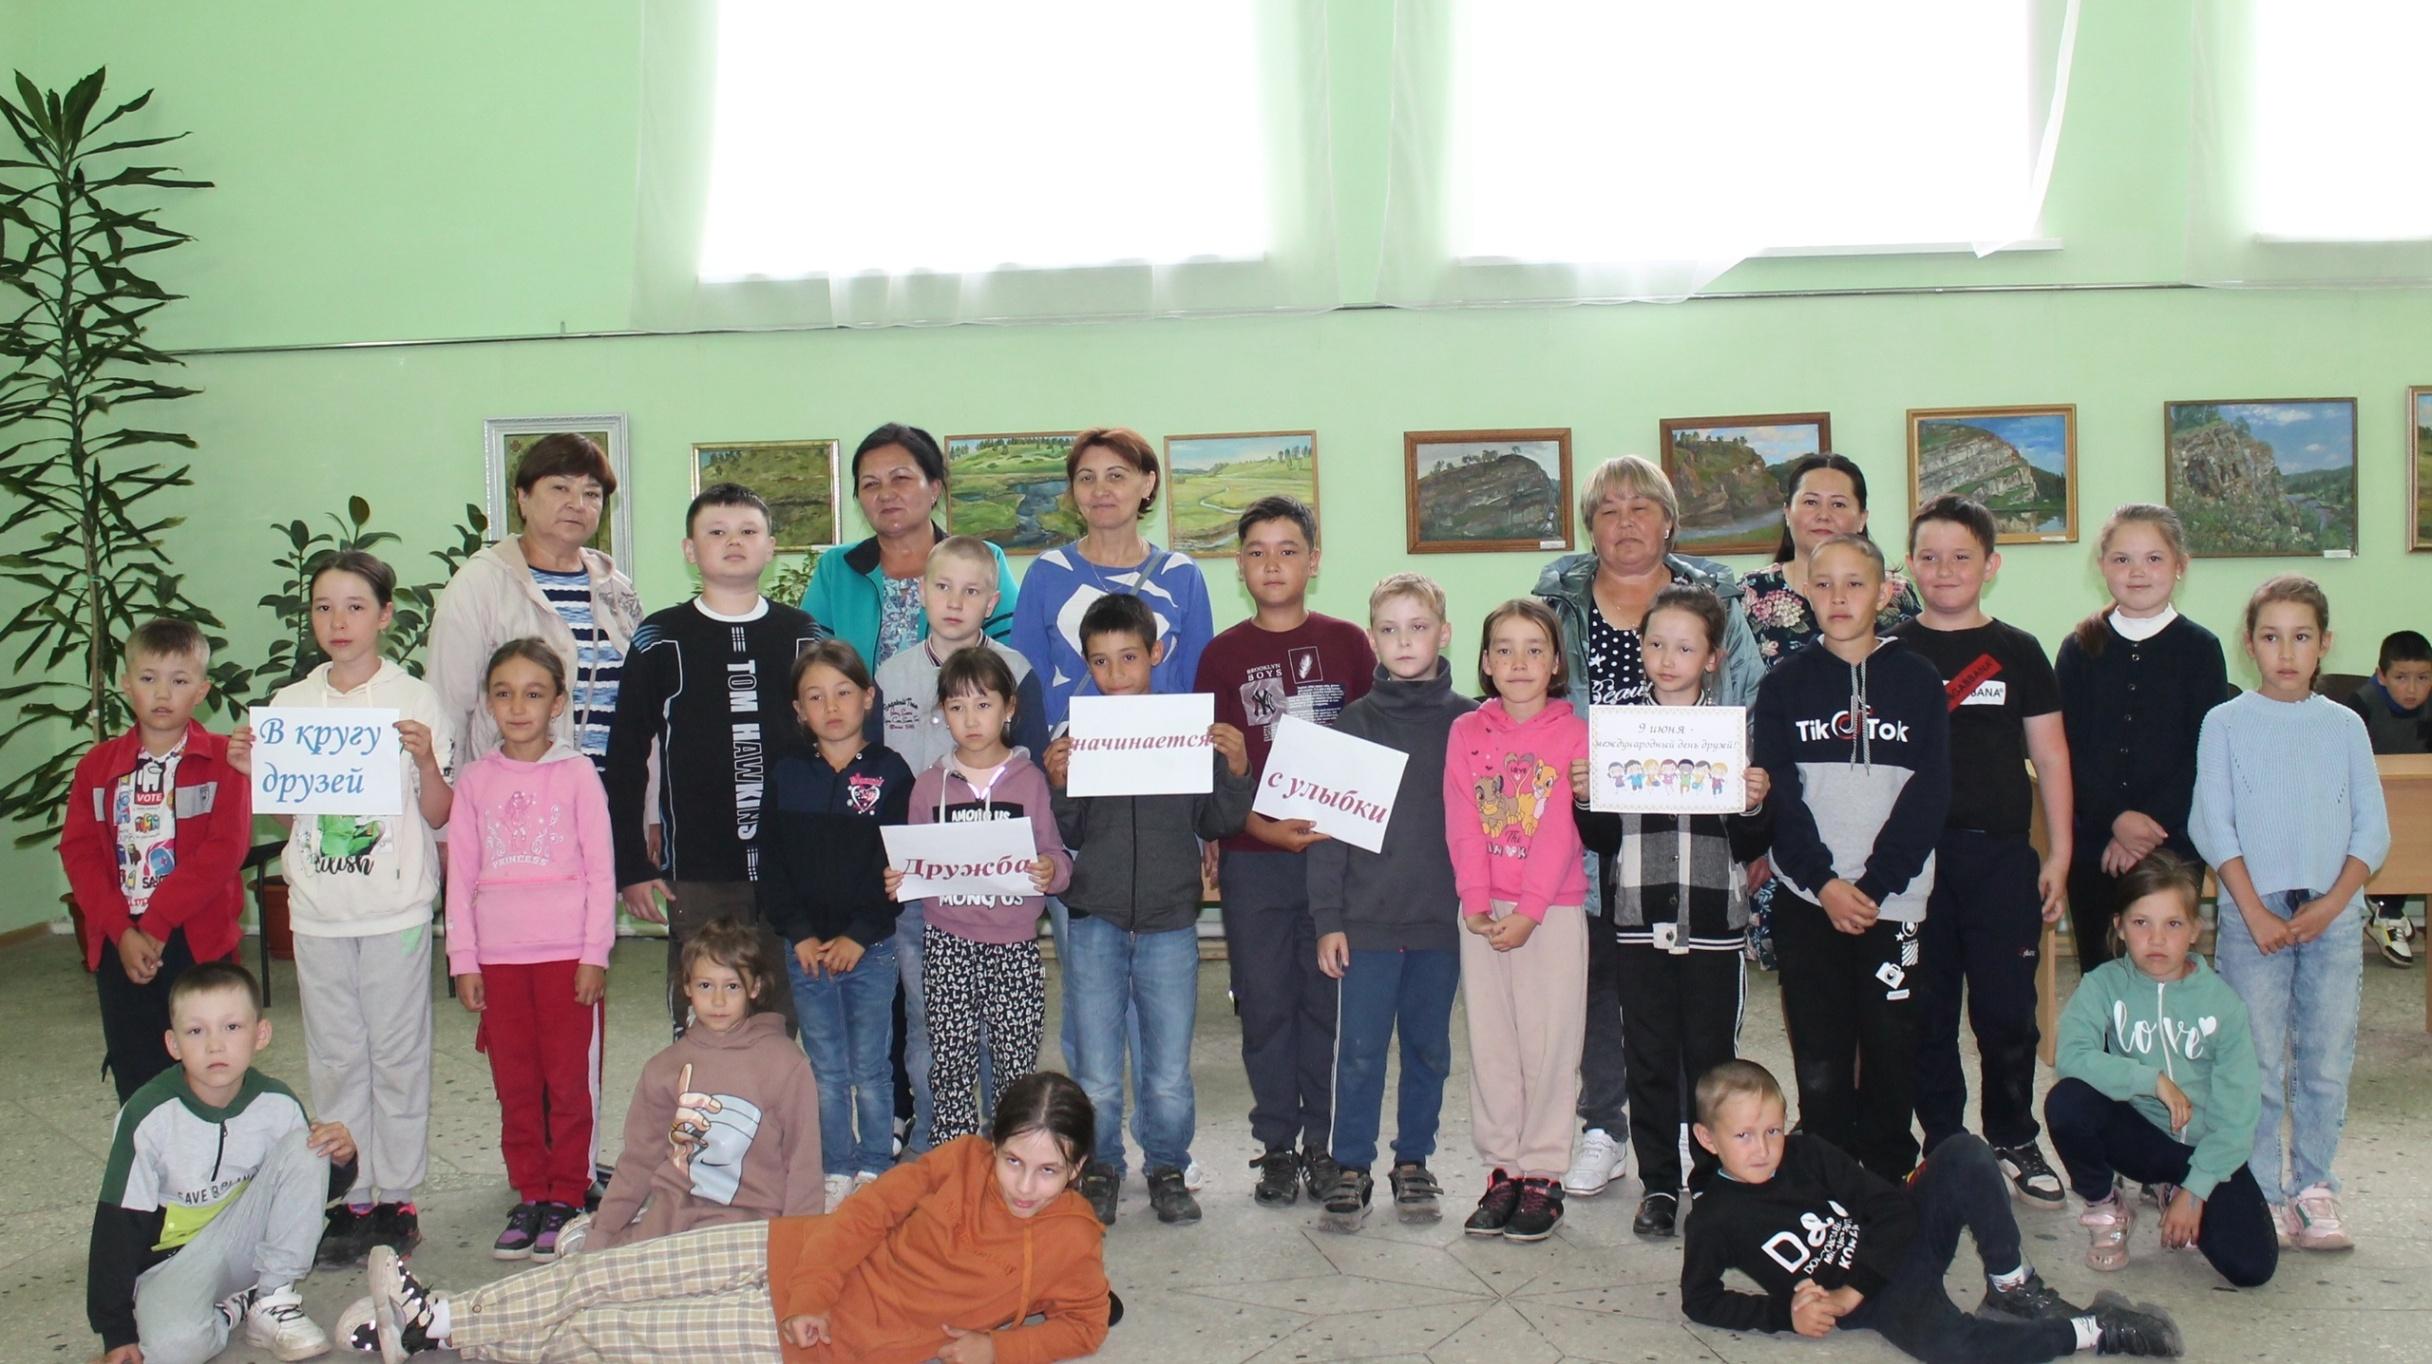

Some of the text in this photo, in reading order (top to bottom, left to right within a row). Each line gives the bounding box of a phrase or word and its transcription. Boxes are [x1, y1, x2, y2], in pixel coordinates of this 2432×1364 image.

[1247, 668, 1283, 682] BOYS
[259, 718, 381, 756] В кругу
[1071, 732, 1212, 751] начинается
[1650, 725, 1685, 735] июня
[1795, 718, 1910, 743] Tik Tok
[727, 659, 764, 841] TOM HAWKINS
[262, 761, 365, 803] друзей
[136, 792, 162, 803] VOTE
[1283, 776, 1388, 824] улыбки
[951, 808, 1011, 822] AMONG US
[903, 854, 1032, 880] Дружба
[2113, 1000, 2204, 1060] love
[177, 1189, 208, 1205] SAVE
